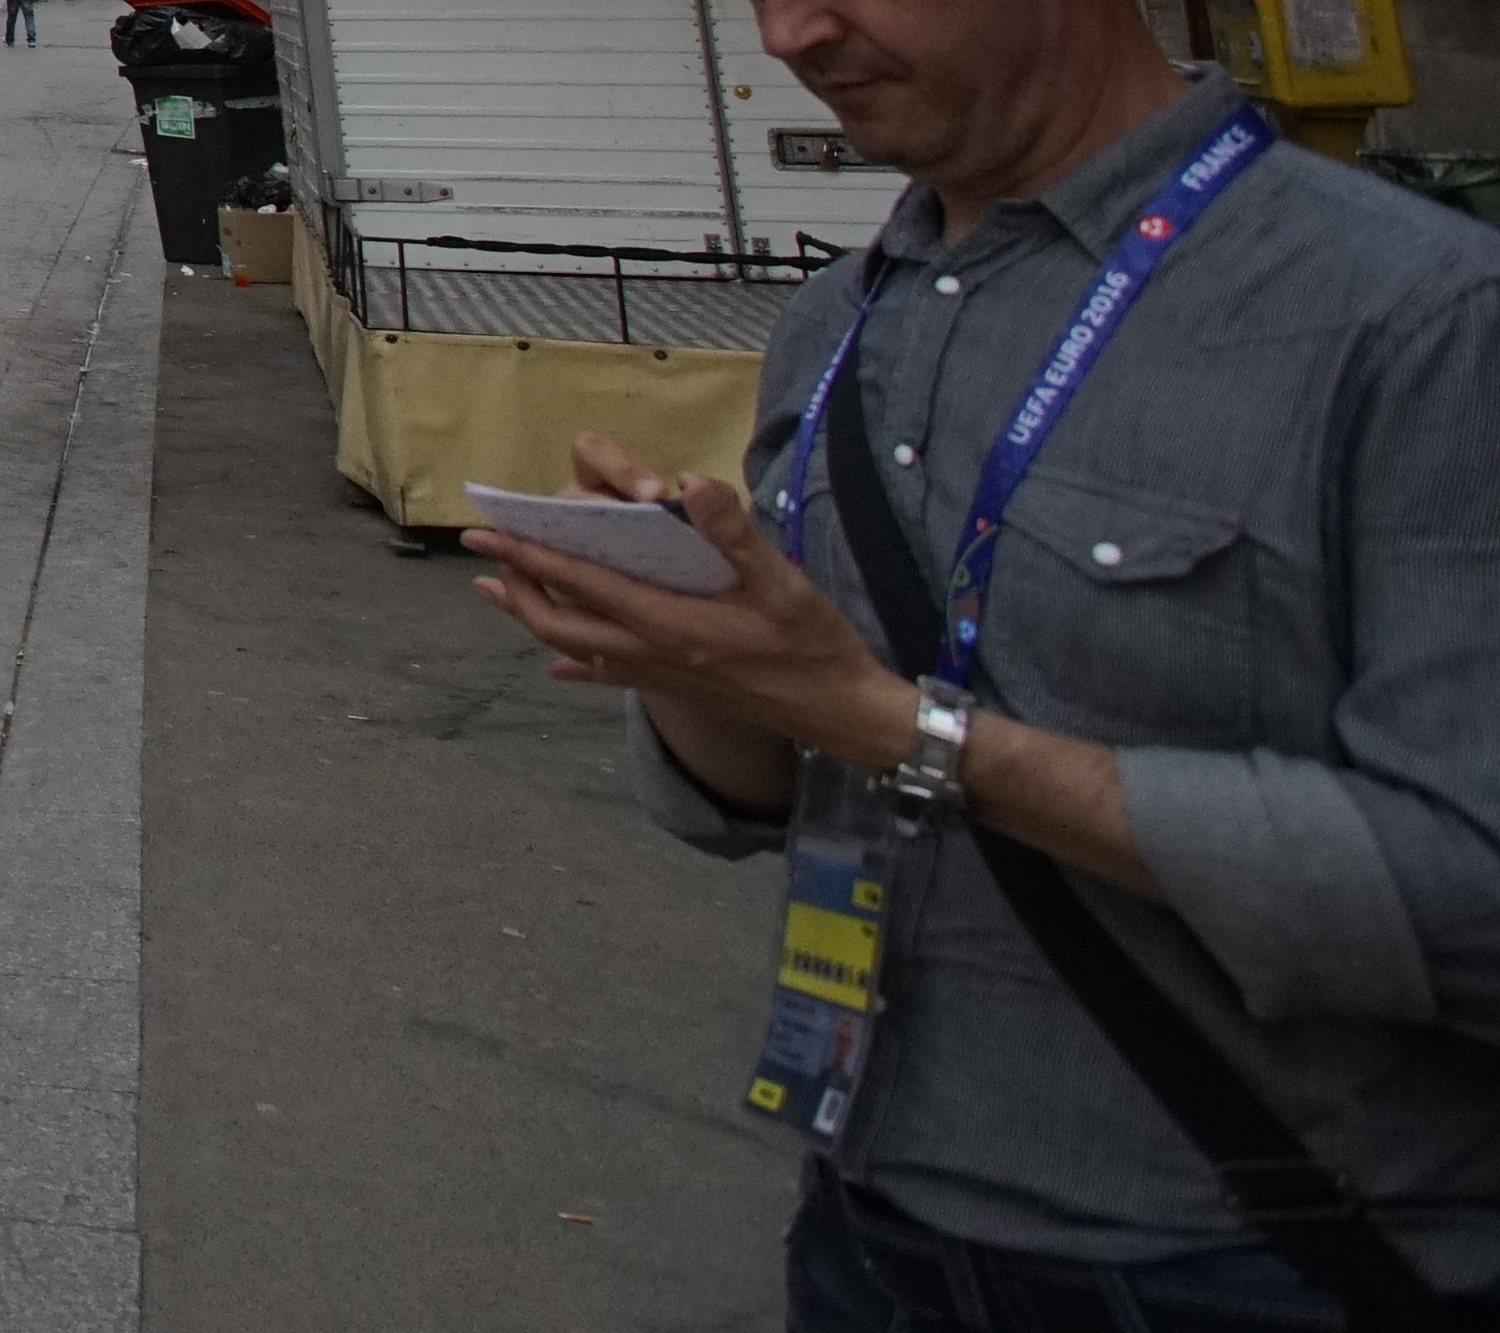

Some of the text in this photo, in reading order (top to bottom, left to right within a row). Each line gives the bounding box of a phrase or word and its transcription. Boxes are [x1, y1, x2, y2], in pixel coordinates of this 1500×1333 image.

[1181, 124, 1256, 192] FRANCE
[1007, 270, 1130, 445] UEFA EURO 2016
